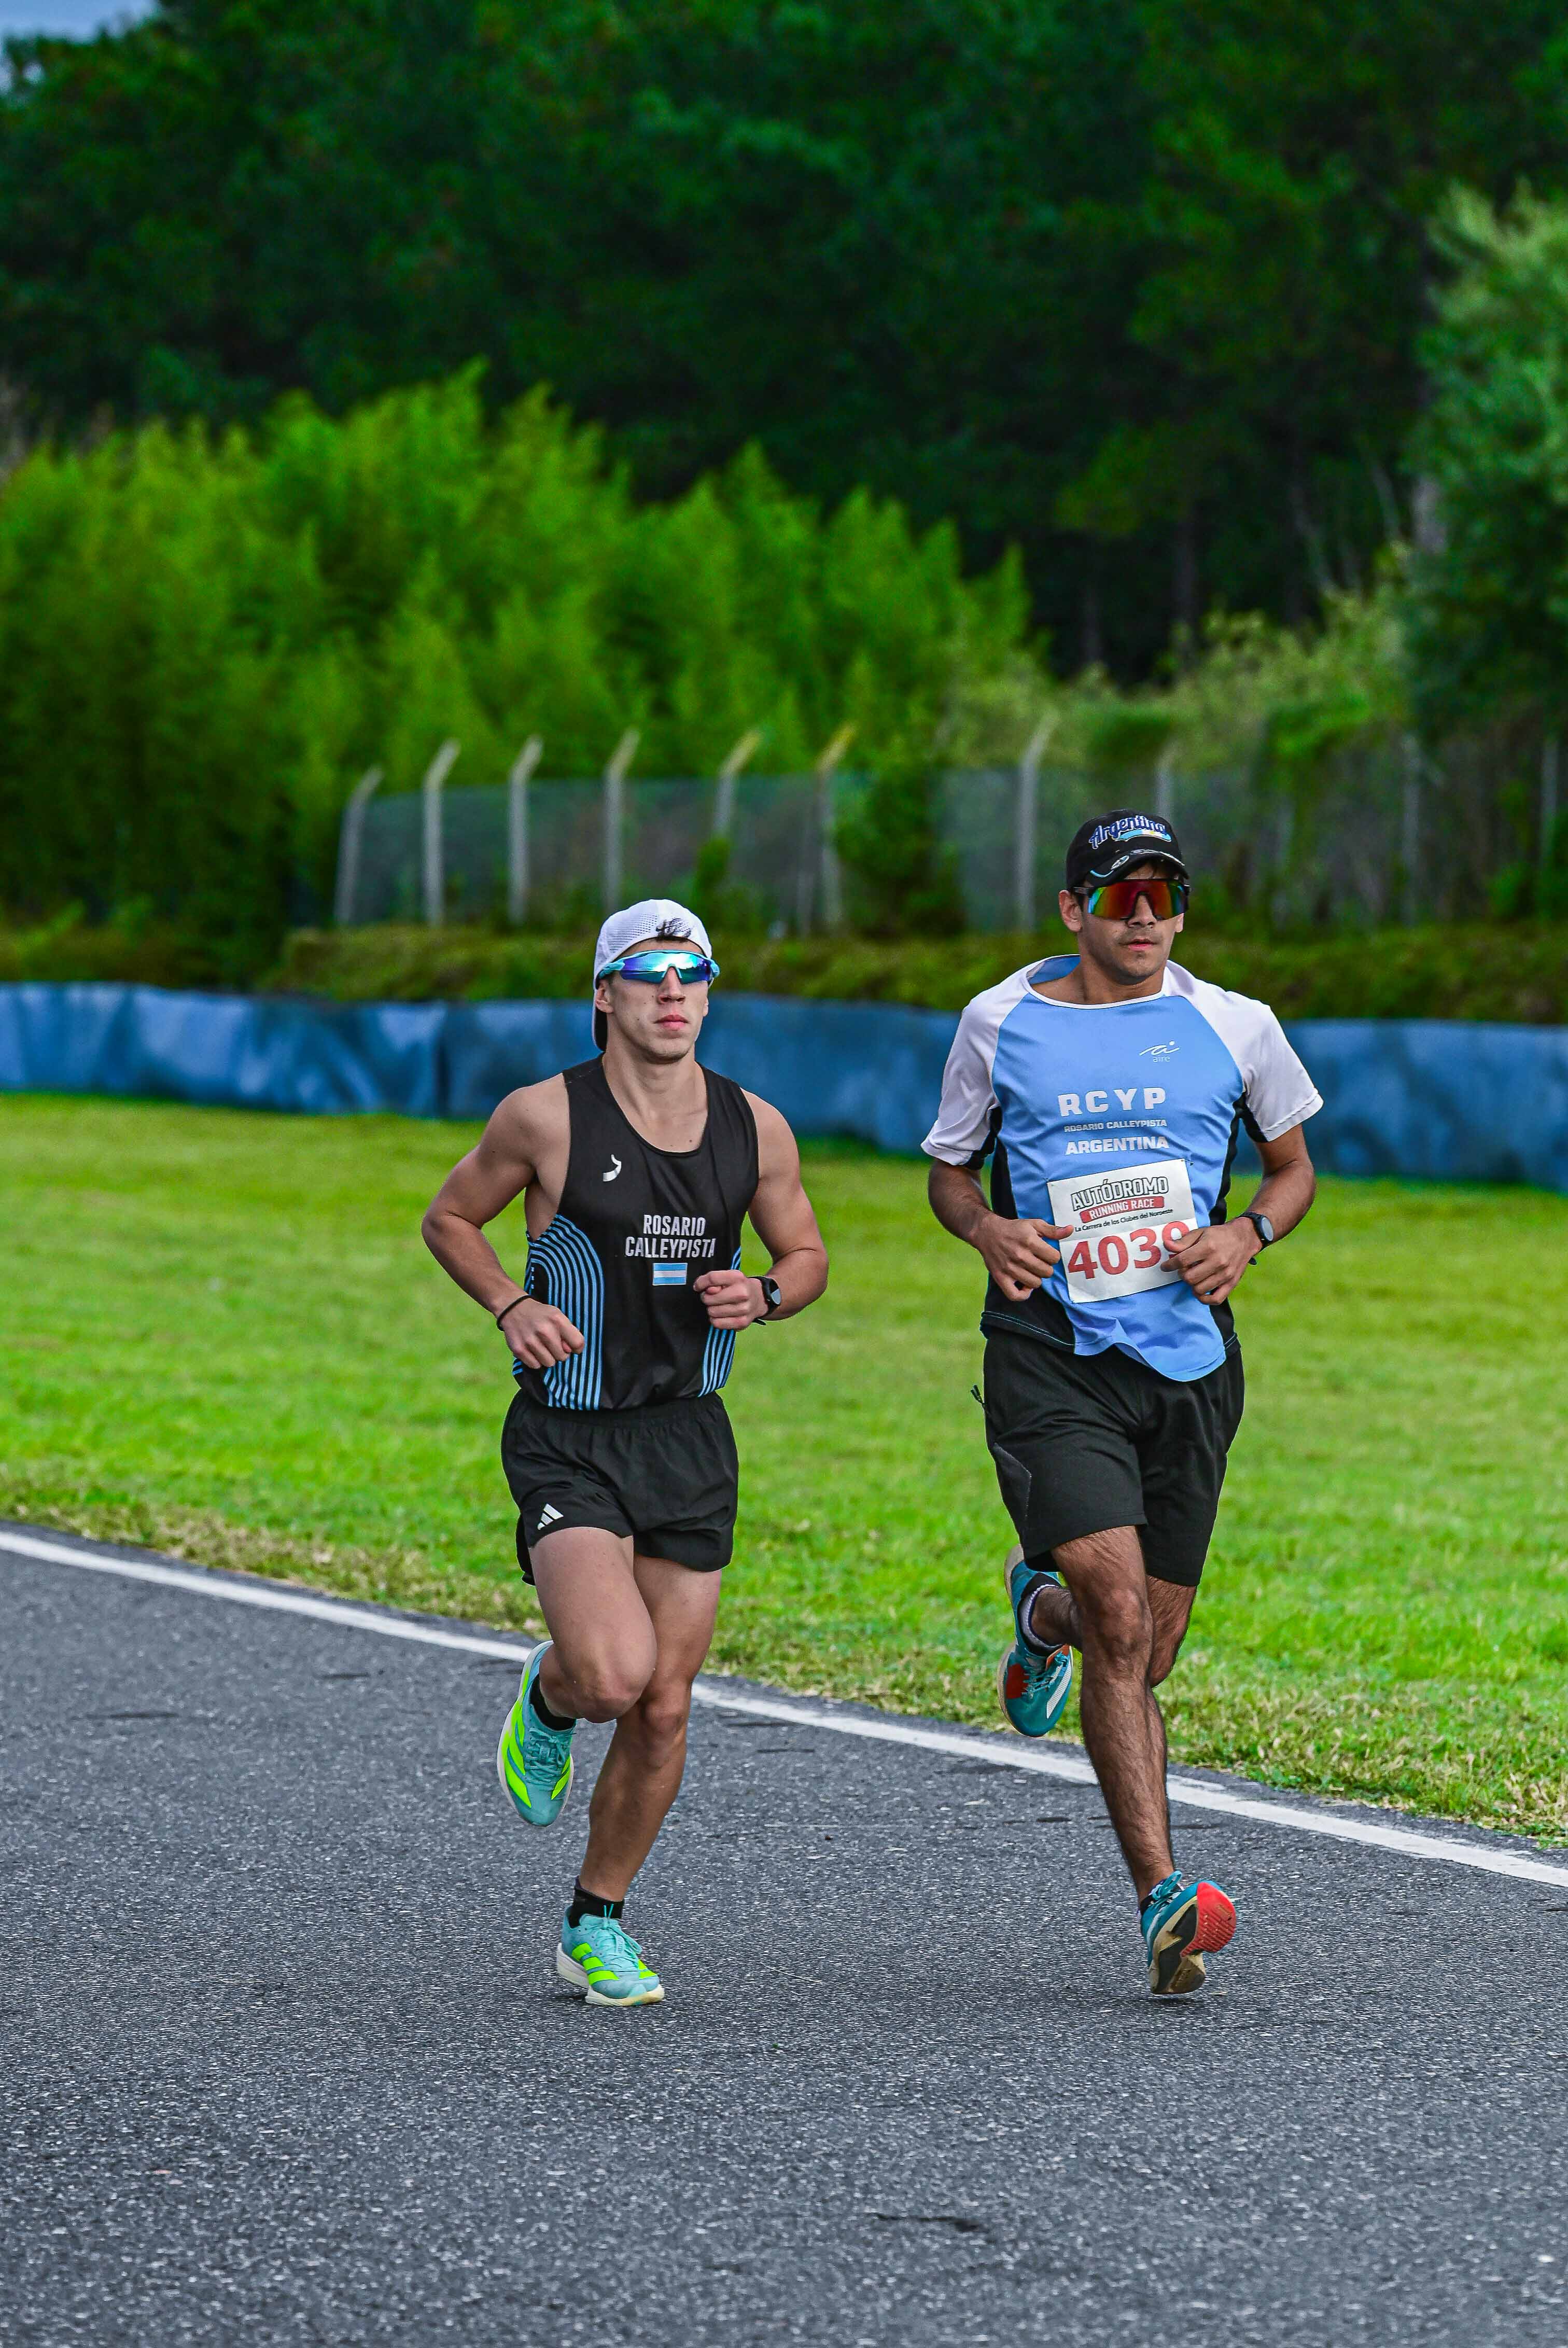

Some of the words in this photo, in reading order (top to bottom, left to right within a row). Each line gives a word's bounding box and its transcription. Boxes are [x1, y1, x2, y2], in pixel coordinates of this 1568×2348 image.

[1064, 1122, 1104, 1133] ROSARIO
[1106, 1119, 1167, 1129] CALLEYPISTA
[1066, 1136, 1170, 1155] ARGENTINA
[1070, 1176, 1169, 1212] AUTÓDROMO
[1082, 1222, 1102, 1231] Carrera
[1121, 1214, 1139, 1223] Clubes
[1149, 1208, 1173, 1218] Noroeste
[1088, 1200, 1129, 1220] RUNNING
[1130, 1198, 1155, 1210] RACE
[643, 1214, 706, 1236] ROSARIO
[625, 1236, 716, 1258] CALLEYPISTA
[1068, 1221, 1189, 1279] 4039
